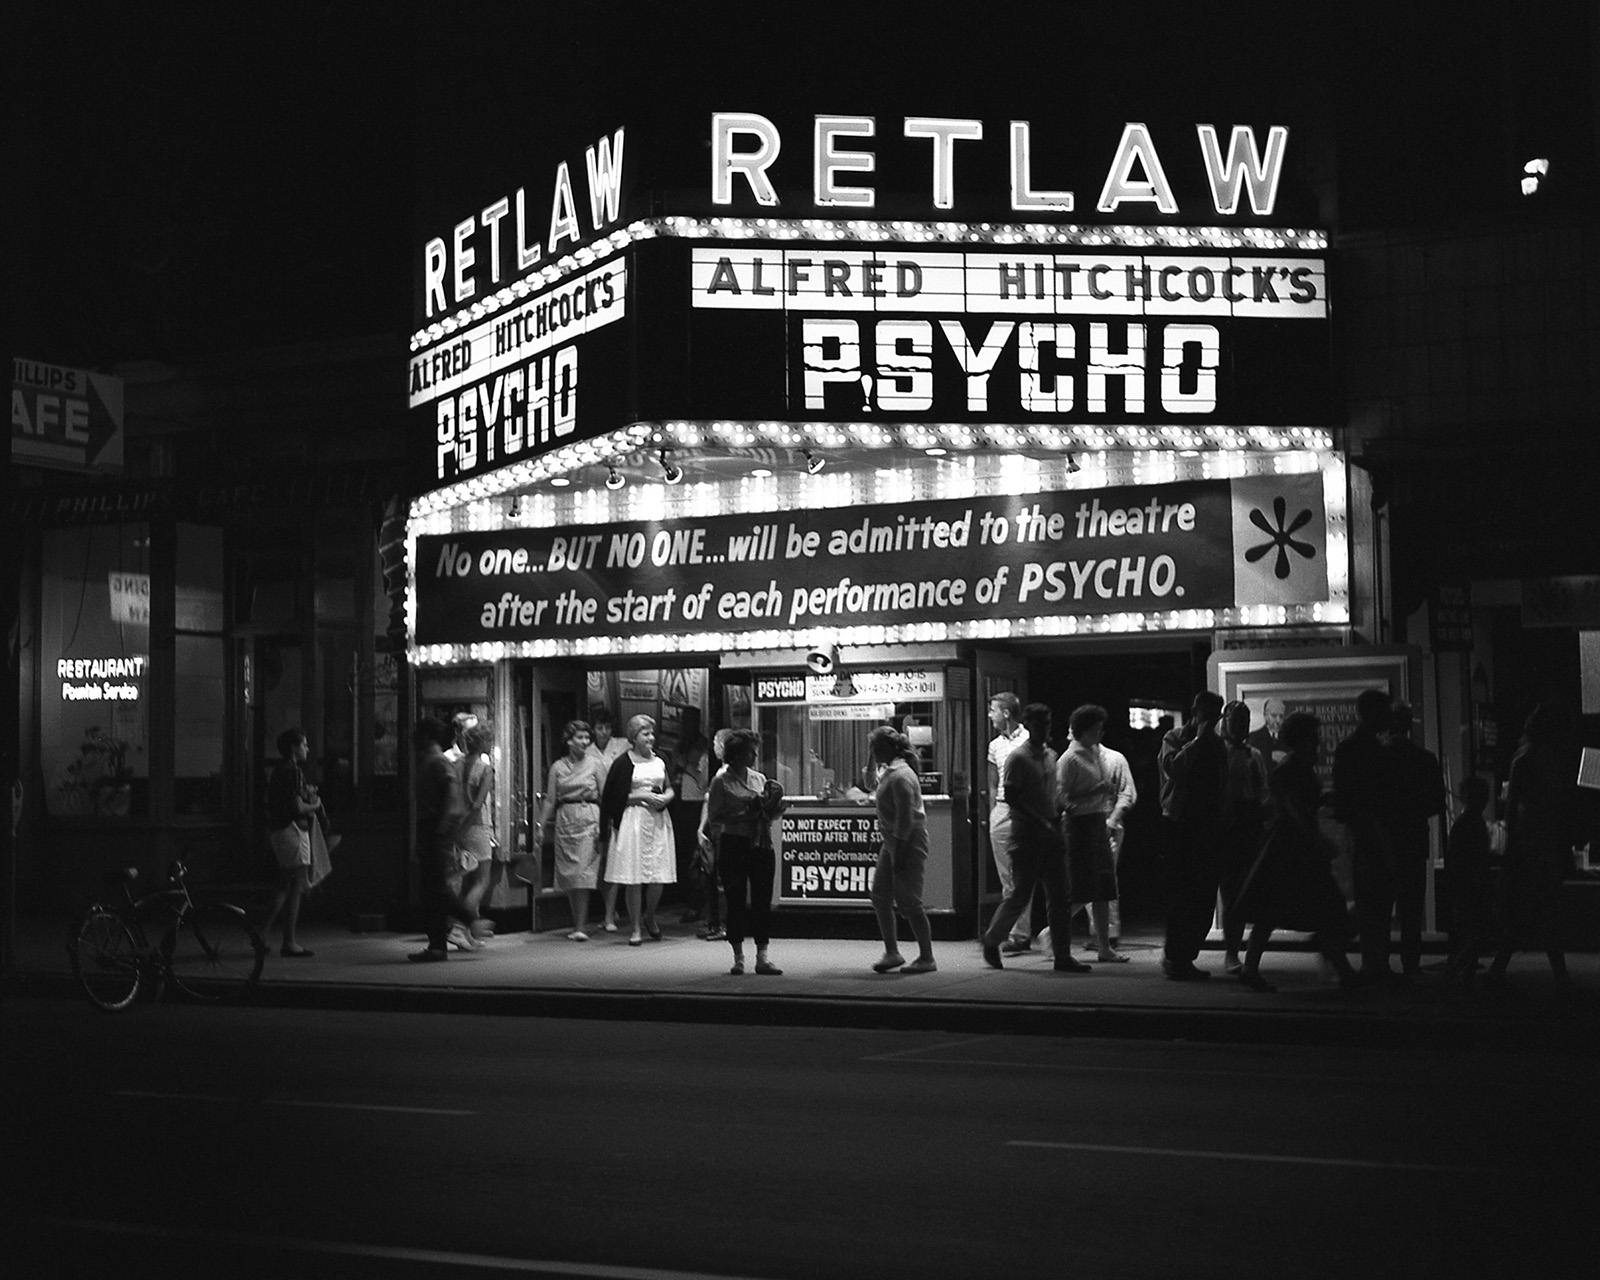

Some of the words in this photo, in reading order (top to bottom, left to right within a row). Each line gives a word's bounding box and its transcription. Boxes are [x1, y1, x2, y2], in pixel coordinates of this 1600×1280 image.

[711, 112, 1290, 215] RETLAW
[425, 125, 625, 318] RETLAW
[707, 257, 923, 299] ALFRED
[999, 263, 1317, 305] HITCHCOCK'S
[410, 339, 472, 396] ALFRED
[495, 271, 615, 357] HITCHCOCK'S
[802, 318, 1221, 414] PSYCHO
[437, 345, 578, 480] PSYCHO
[435, 543, 472, 578] No
[606, 531, 646, 569] NO
[785, 523, 821, 558] be
[827, 510, 973, 556] admitted
[979, 510, 1009, 546] to
[1015, 504, 1066, 543] the
[1075, 497, 1196, 539] theatre
[480, 592, 549, 628] after
[554, 589, 598, 625] the
[606, 588, 677, 623] start
[682, 583, 714, 620] of
[717, 580, 783, 619] each
[789, 574, 966, 625] performance
[974, 565, 1009, 603] of
[1018, 554, 1185, 603] PSYCHO.
[57, 656, 144, 679] RESTAURANT
[62, 681, 103, 701] Fountain
[103, 681, 138, 701] Service
[757, 679, 805, 699] PSYCHO
[782, 819, 795, 831] DO
[797, 819, 815, 830] NOT
[817, 819, 852, 830] EXPECT
[857, 819, 870, 830] TO
[782, 832, 823, 842] ADMITTED
[824, 832, 849, 842] AFTER
[852, 832, 868, 842] THE
[783, 849, 797, 861] of
[798, 849, 821, 861] each
[823, 849, 878, 864] performance
